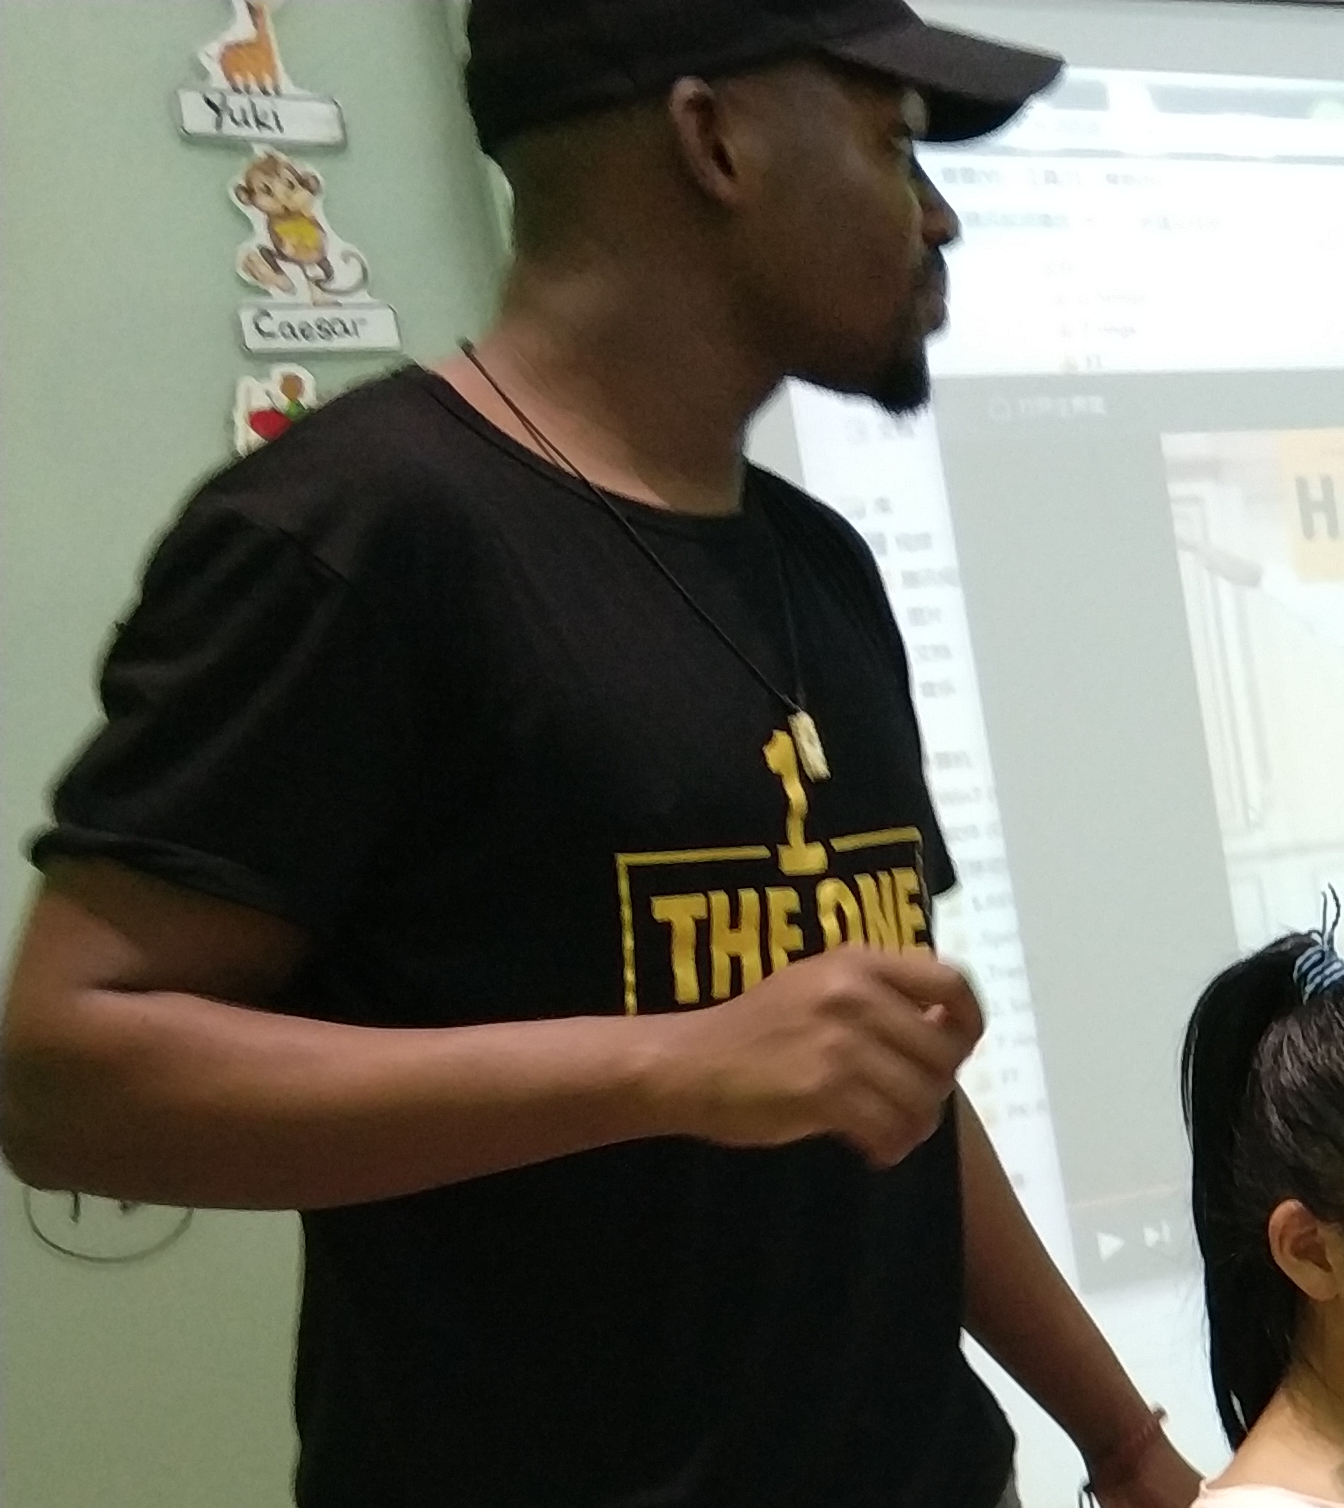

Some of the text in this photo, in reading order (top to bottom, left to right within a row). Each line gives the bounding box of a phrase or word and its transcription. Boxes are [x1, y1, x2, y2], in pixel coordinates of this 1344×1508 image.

[203, 92, 285, 132] Yuki
[252, 309, 367, 341] Caesar
[650, 866, 937, 1005] THE ONE
